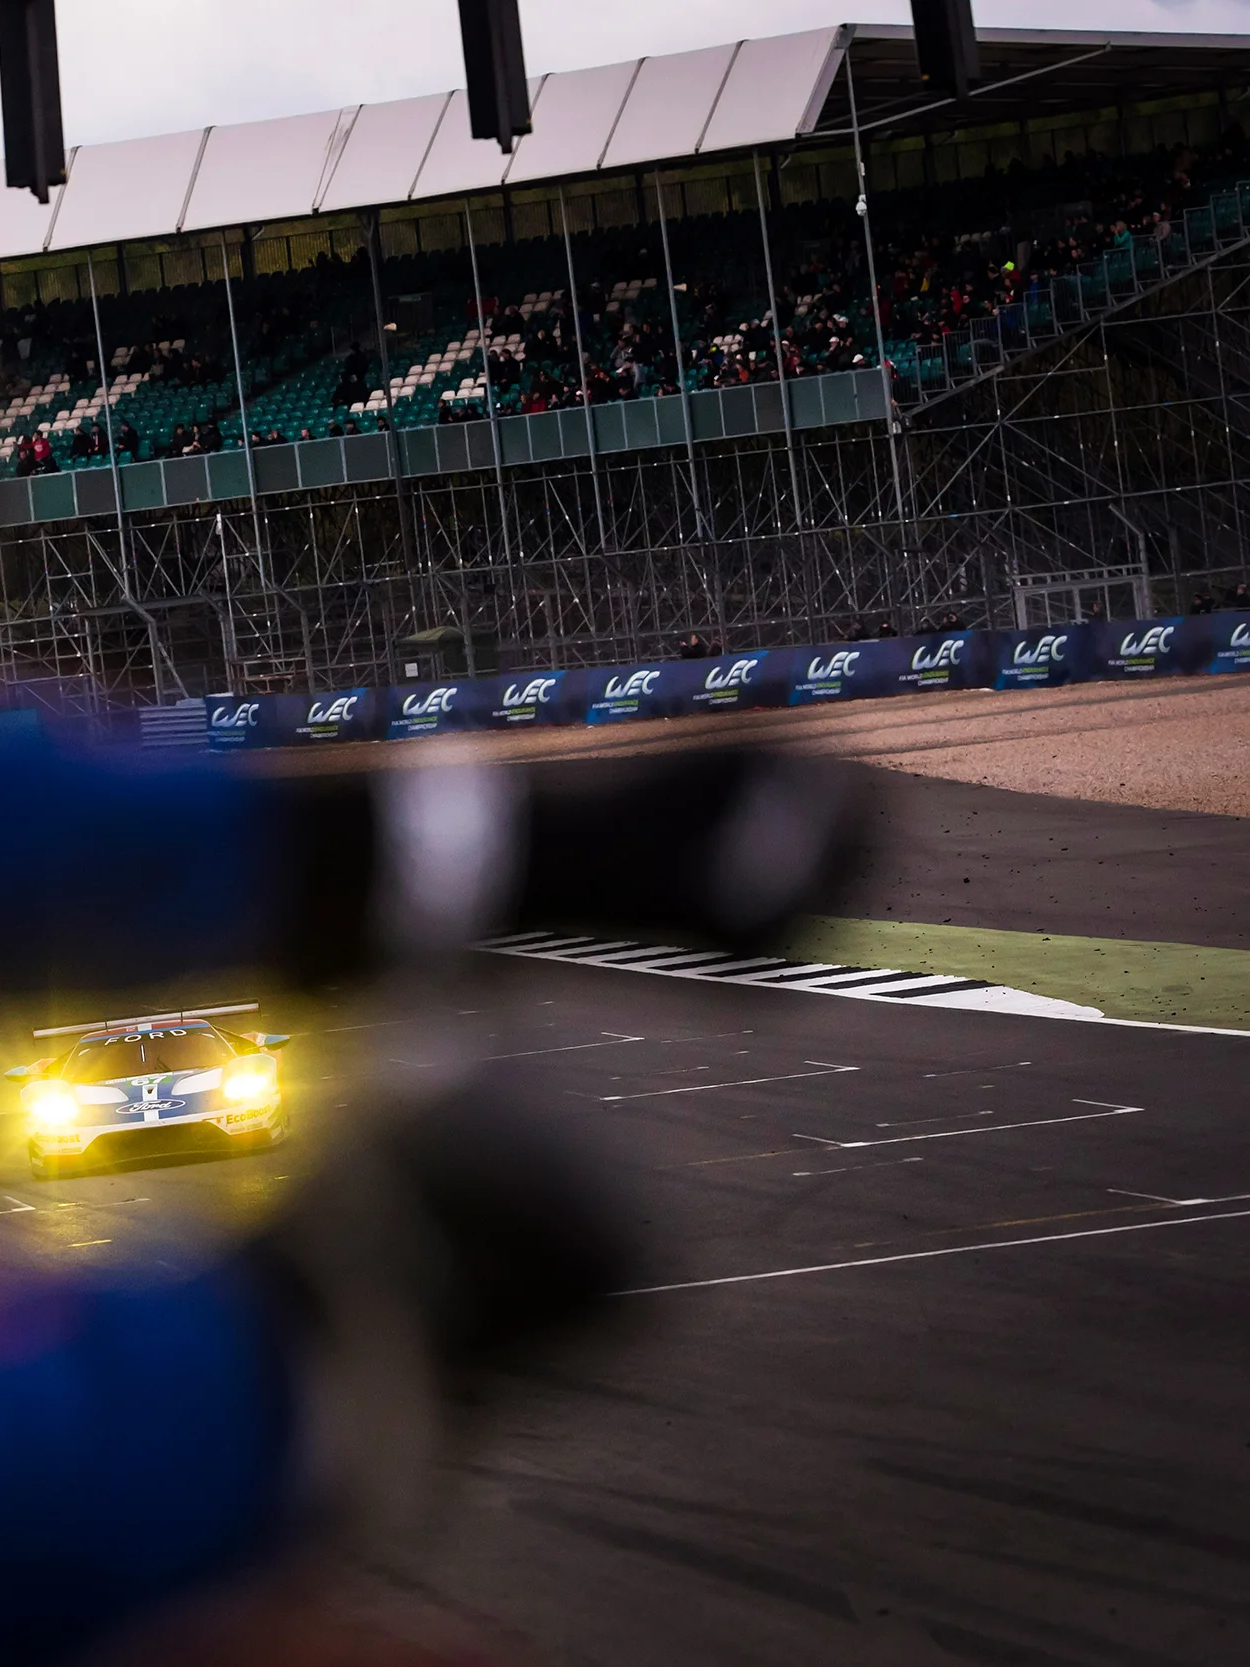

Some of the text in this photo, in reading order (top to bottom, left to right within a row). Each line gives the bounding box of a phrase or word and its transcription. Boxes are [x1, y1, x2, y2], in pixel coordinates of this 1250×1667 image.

[1014, 636, 1068, 664] WEC
[1120, 626, 1174, 655] WEC
[808, 652, 860, 680] WEC
[912, 640, 964, 670] WEC
[605, 670, 661, 698] WEC
[705, 659, 758, 689] WEC
[403, 688, 458, 716] WEC
[503, 678, 556, 707] WEC
[212, 704, 259, 727] WEC
[308, 696, 357, 723] WEC
[104, 1030, 187, 1046] FORD
[131, 1076, 167, 1086] 67
[128, 1101, 172, 1112] Ford
[226, 1104, 271, 1124] EcoBoost
